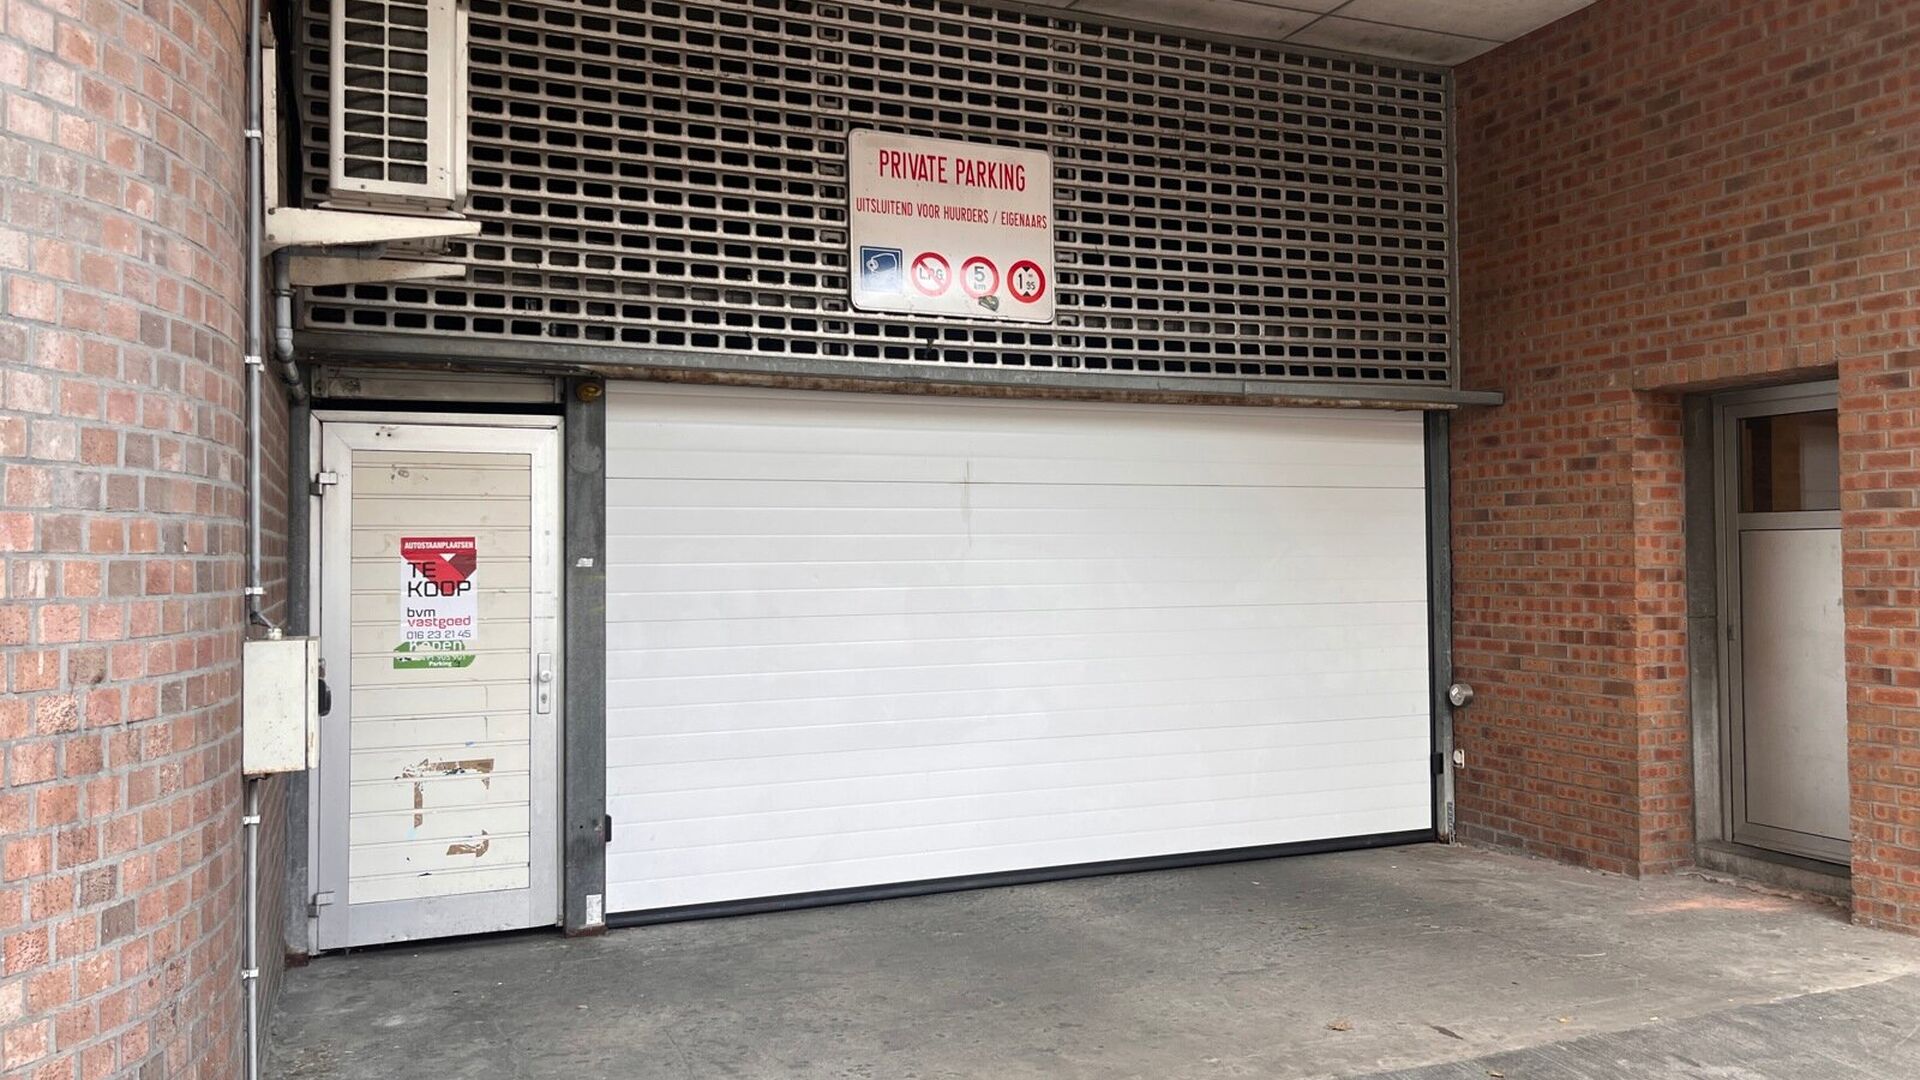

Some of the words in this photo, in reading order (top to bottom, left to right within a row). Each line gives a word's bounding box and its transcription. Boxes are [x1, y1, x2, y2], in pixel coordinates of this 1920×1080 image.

[879, 149, 948, 184] PRIVATE
[955, 158, 1026, 192] PARKING
[855, 197, 913, 217] UITSLUITEND
[916, 203, 941, 219] VOOR
[943, 207, 989, 224] HUURDERS
[1001, 211, 1048, 230] EIGENAARS
[973, 266, 986, 282] 5
[404, 541, 474, 550] AUTOSTAANPLAATSEN
[407, 562, 436, 578] TE
[407, 580, 472, 598] KOOP
[407, 607, 436, 618] bvm
[407, 615, 472, 630] vastgoed
[406, 630, 425, 640] 016
[427, 630, 441, 639] 23
[444, 630, 455, 639] 21
[457, 629, 472, 639] 45
